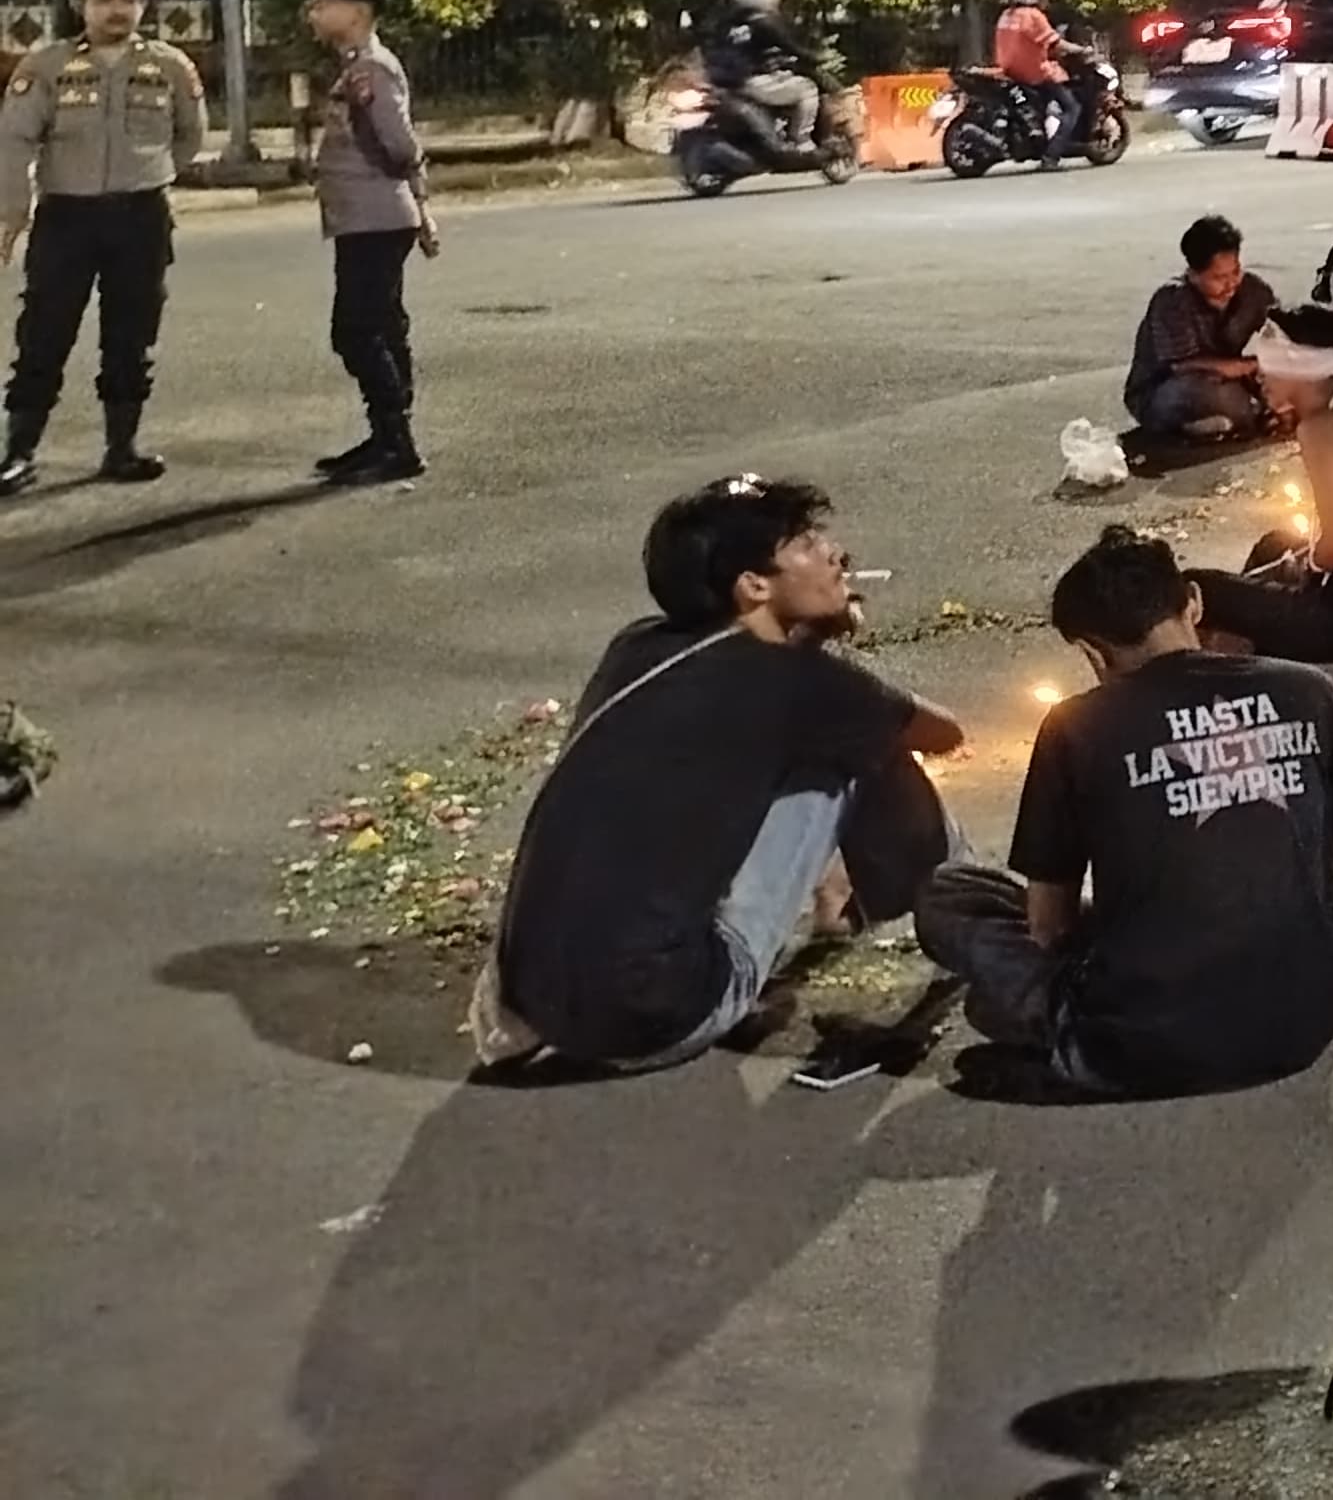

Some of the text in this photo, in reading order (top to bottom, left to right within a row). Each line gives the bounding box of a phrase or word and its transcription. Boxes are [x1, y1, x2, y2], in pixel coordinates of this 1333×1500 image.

[1166, 693, 1279, 741] HASTA
[1125, 721, 1321, 788] LA VICTORIA
[1165, 761, 1305, 818] SIEMPRE
